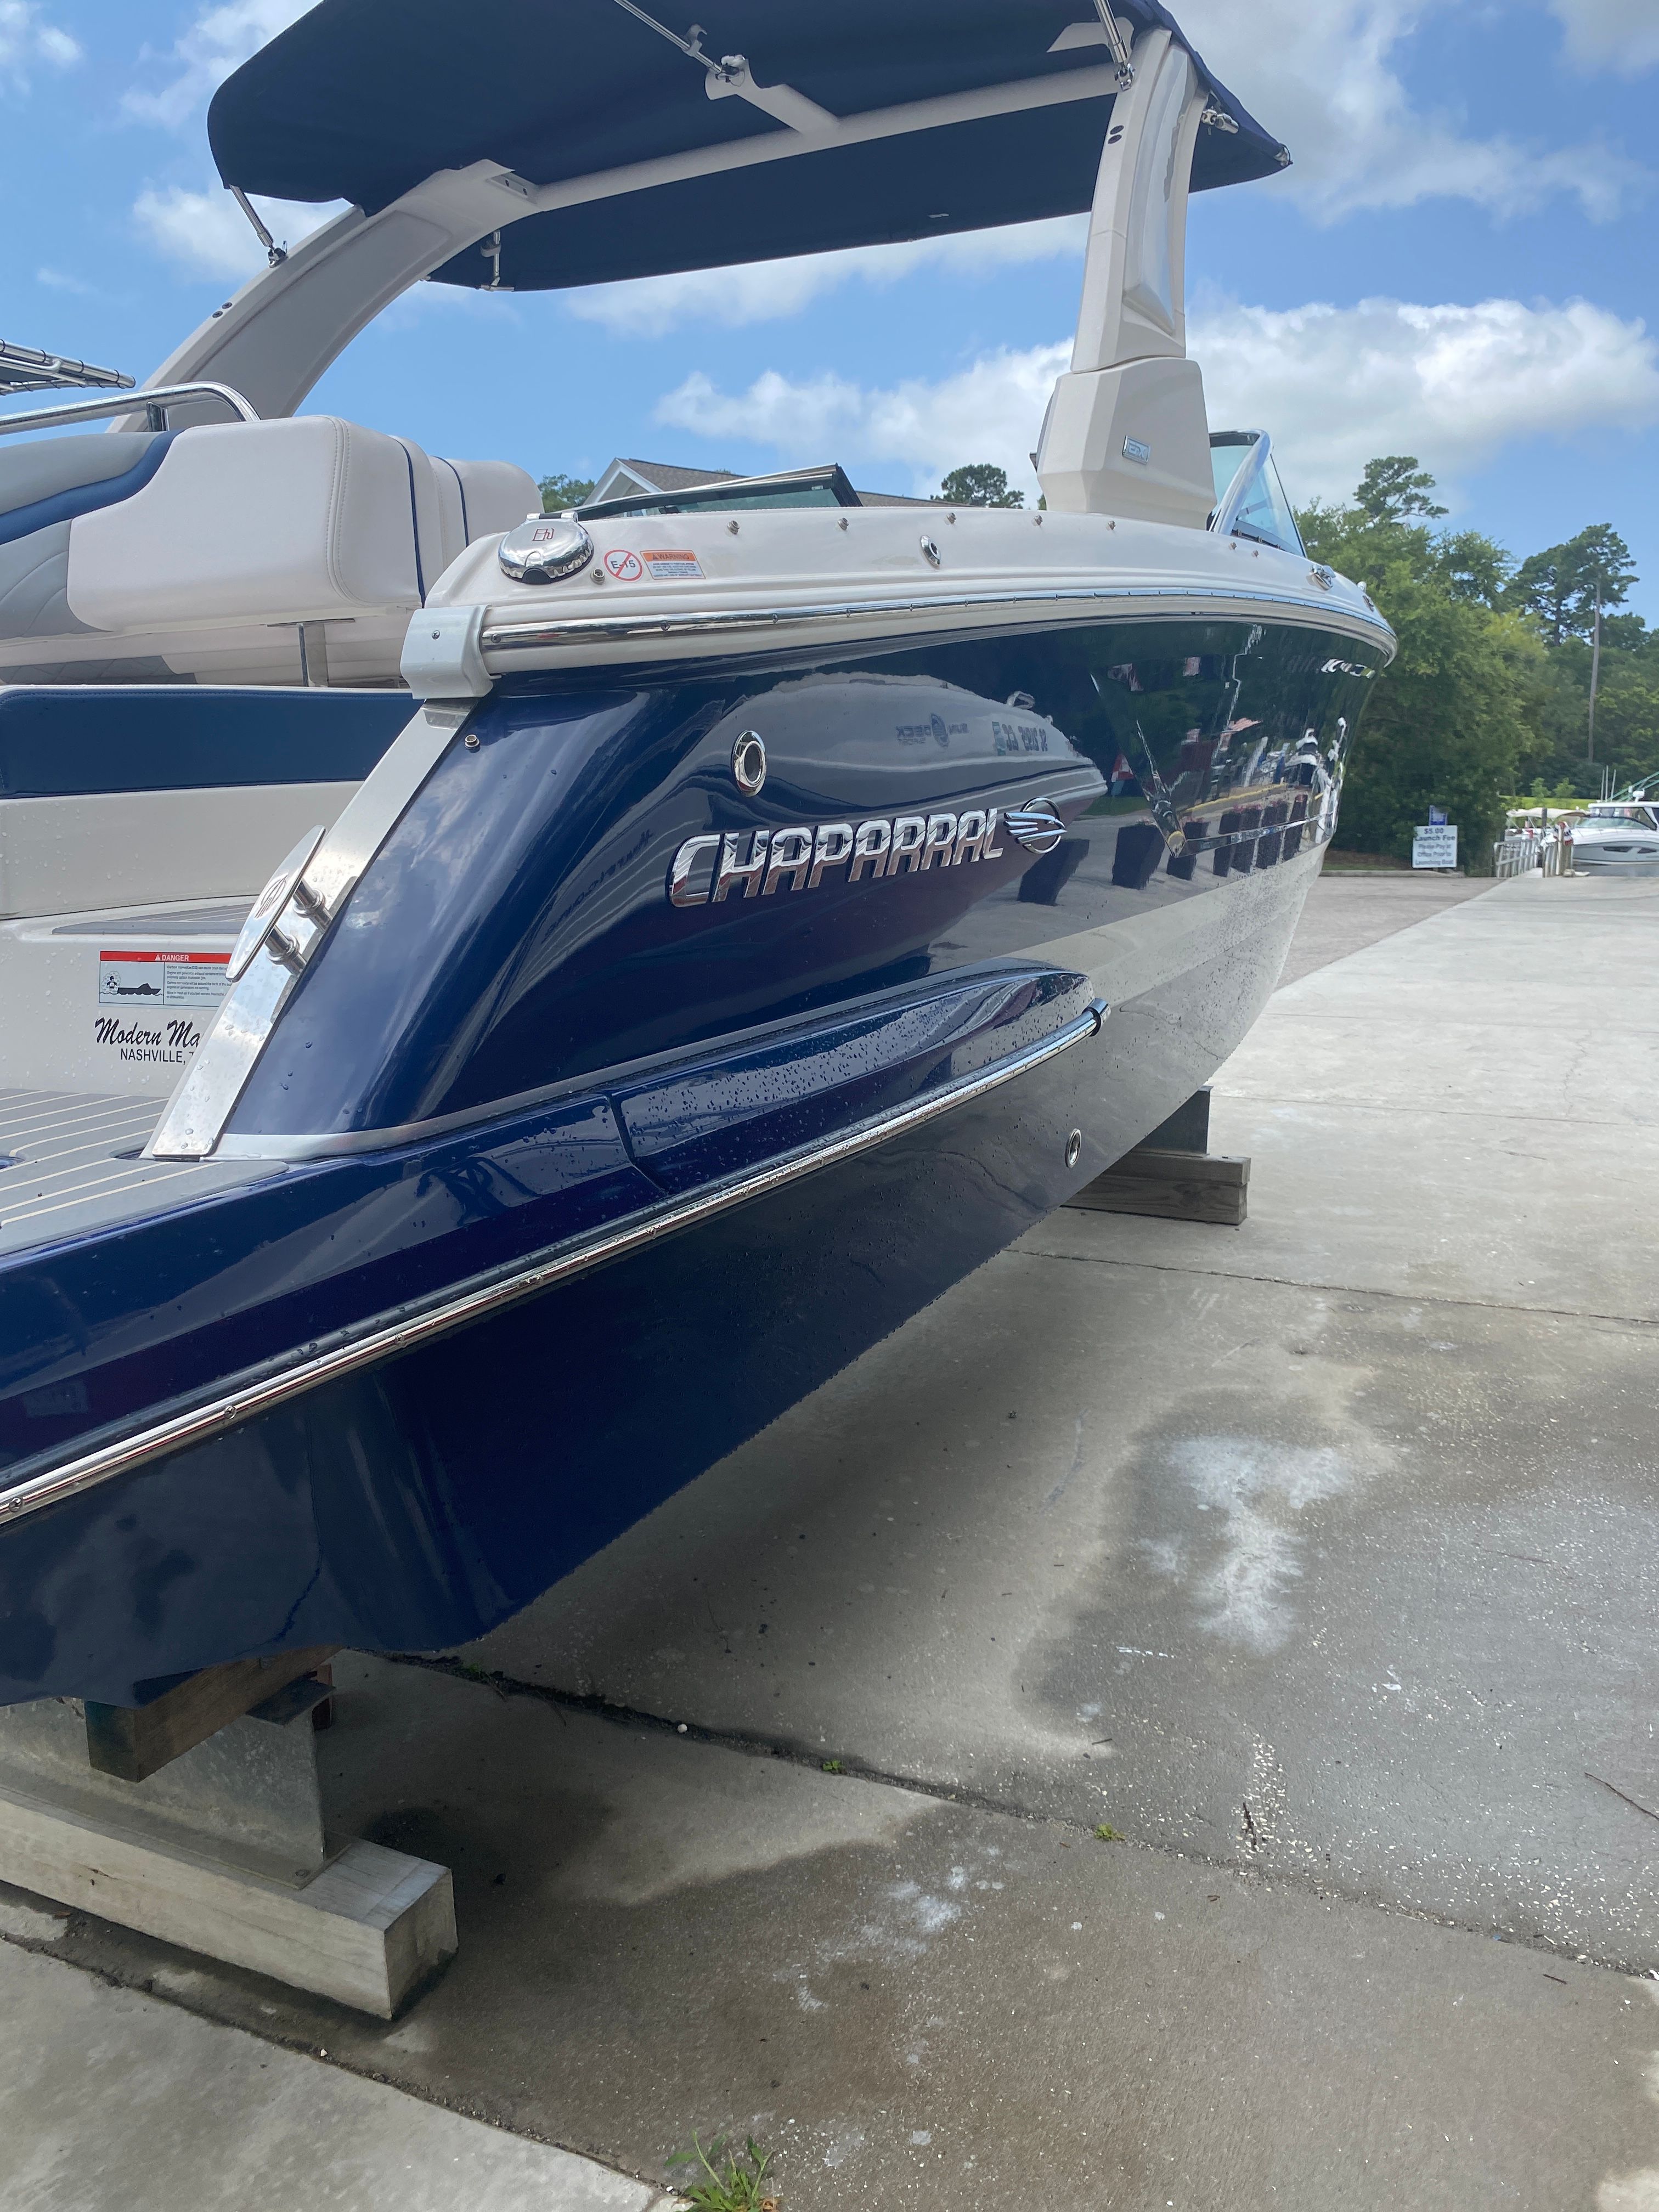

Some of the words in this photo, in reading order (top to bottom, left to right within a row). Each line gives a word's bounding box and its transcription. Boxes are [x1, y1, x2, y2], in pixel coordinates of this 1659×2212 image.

[610, 560, 636, 569] E-15
[668, 808, 1003, 909] CHAPARRAL
[94, 1017, 162, 1046] Modern
[166, 1019, 201, 1048] Ma
[120, 1048, 186, 1065] NASHVILLE,
